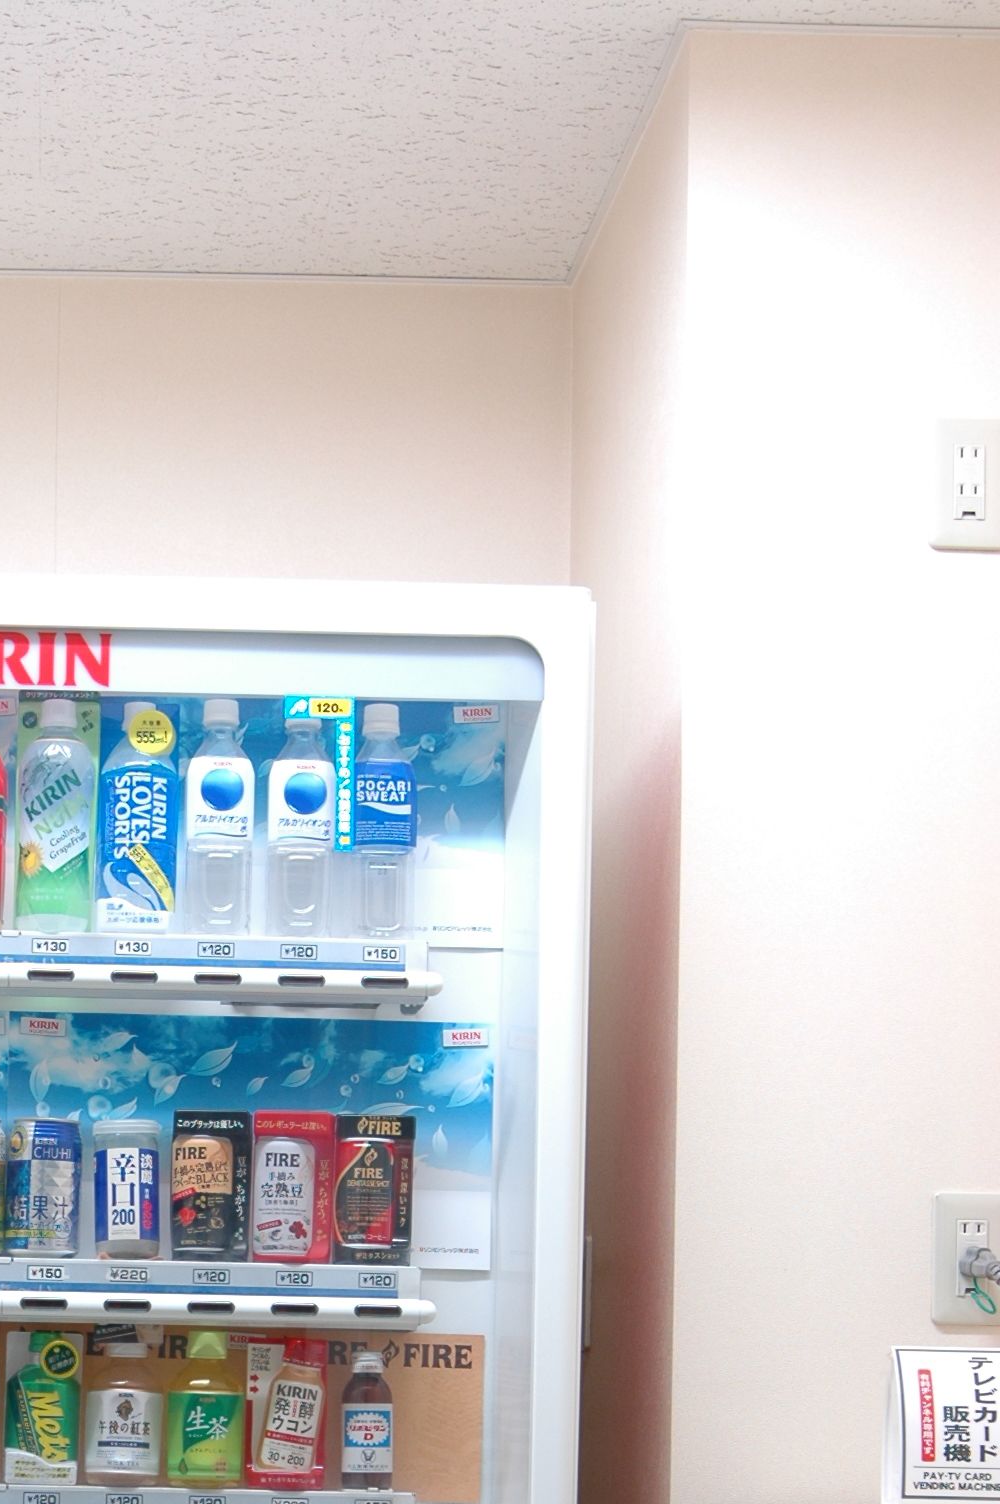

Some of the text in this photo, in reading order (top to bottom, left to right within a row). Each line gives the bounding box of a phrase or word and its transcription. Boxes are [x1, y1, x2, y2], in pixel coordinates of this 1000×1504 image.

[462, 707, 492, 718] KIRIN
[356, 780, 412, 792] POCARI
[25, 769, 82, 822] KIRIN
[356, 791, 408, 802] SWEAT
[131, 775, 150, 844] LOVES
[151, 777, 168, 840] KIRIN
[114, 776, 131, 860] SPORTS
[49, 824, 80, 848] Cooling
[35, 941, 67, 952] ¥130
[118, 942, 149, 953] ¥130
[201, 944, 231, 956] ¥120
[284, 946, 314, 958] ¥120
[367, 949, 397, 960] ¥150
[29, 1020, 59, 1031] KIRIN
[451, 1031, 481, 1042] KIRIN
[367, 1120, 403, 1136] FIRE
[174, 1146, 208, 1161] FIRE
[265, 1152, 301, 1168] FIRE
[110, 1153, 136, 1207] 辛口
[353, 1167, 384, 1179] FIRE
[260, 1182, 304, 1199] 完熟豆
[111, 1208, 136, 1226] 200
[31, 1267, 63, 1279] ¥150
[110, 1268, 148, 1281] ¥220
[196, 1271, 227, 1283] ¥120
[279, 1273, 310, 1285] ¥120
[362, 1275, 393, 1287] ¥120
[403, 1343, 473, 1370] FIRE
[276, 1384, 318, 1401] KIRIN
[968, 1356, 998, 1463] テレビカード
[26, 1389, 72, 1464] Mets
[98, 1419, 151, 1436] 午後の紅茶
[184, 1406, 229, 1441] 生茶
[271, 1415, 313, 1434] ウコン
[363, 1433, 375, 1441] D
[943, 1405, 972, 1463] 販売機
[963, 1471, 993, 1482] CARD
[912, 1481, 1000, 1492] VENDING MACHINE
